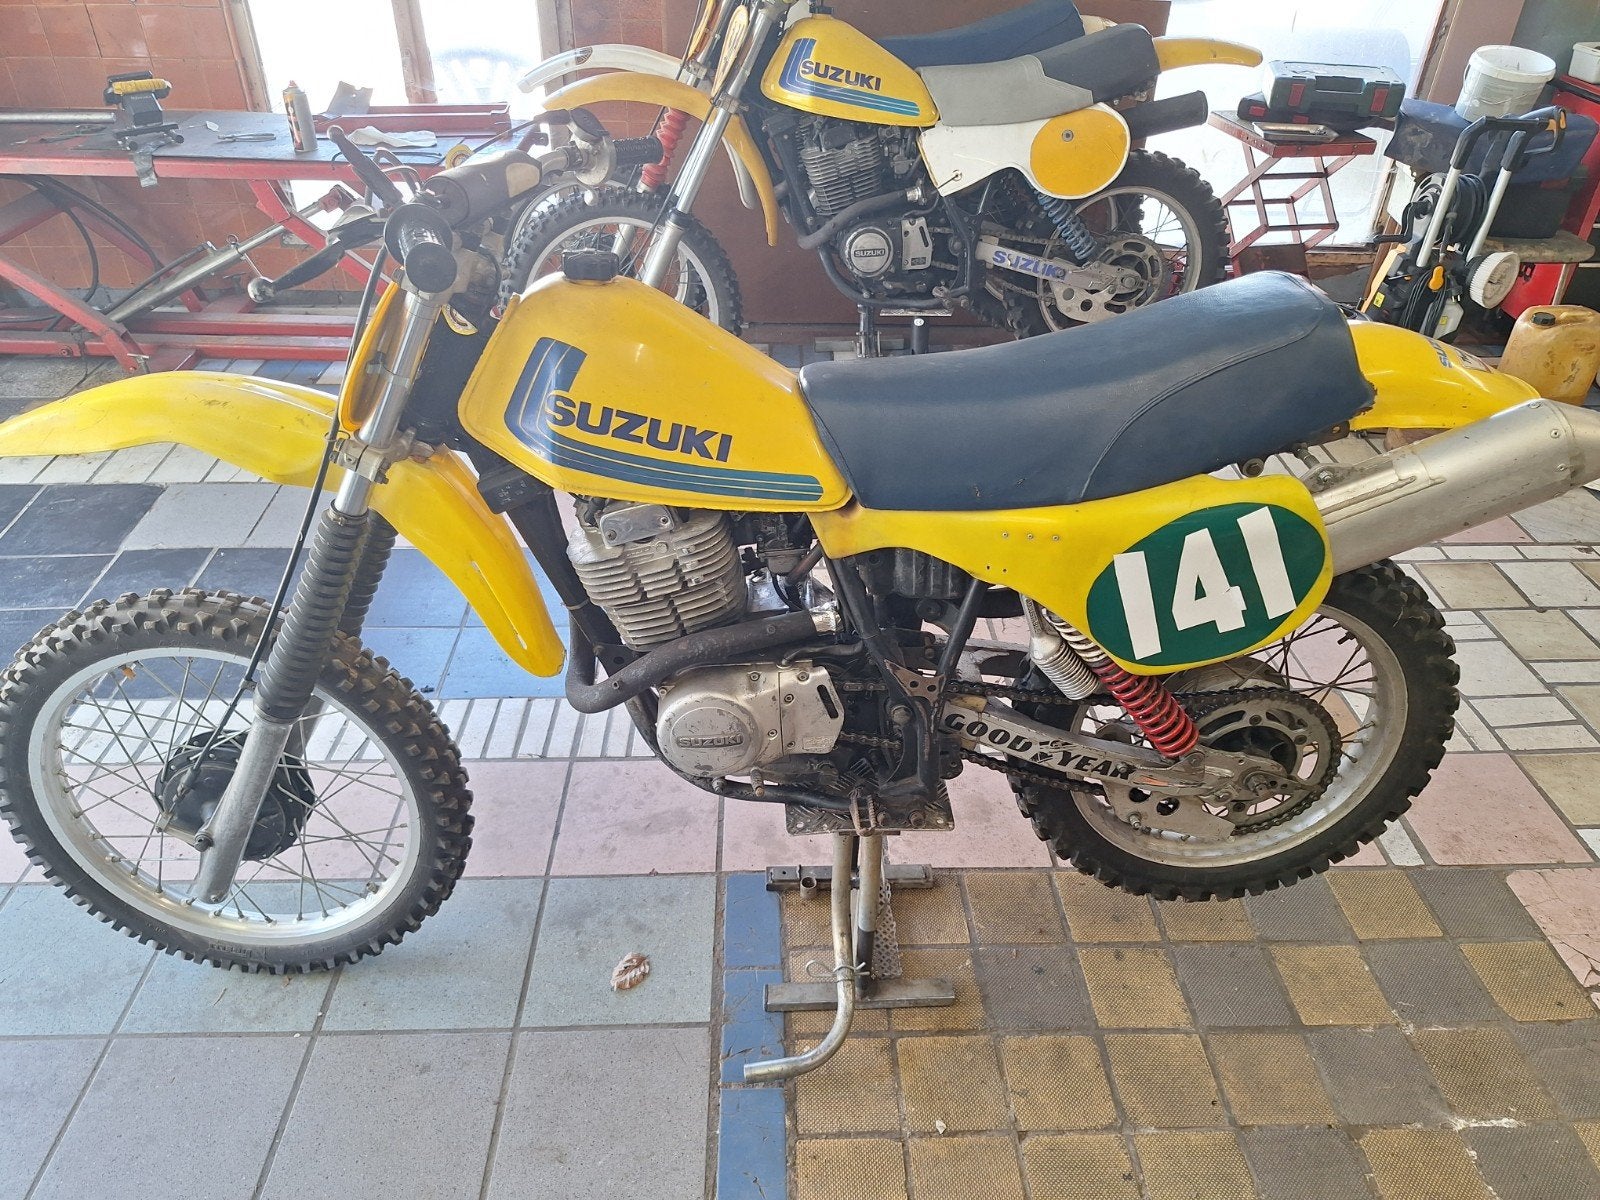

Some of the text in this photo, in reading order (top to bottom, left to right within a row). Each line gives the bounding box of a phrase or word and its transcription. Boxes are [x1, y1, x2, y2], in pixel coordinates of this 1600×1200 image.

[800, 59, 882, 92] SUZUKI
[854, 248, 886, 257] SUZUKI
[544, 394, 733, 463] SUZUKI
[1113, 505, 1298, 661] 141
[678, 733, 743, 748] SUZUKI
[944, 713, 1137, 781] GOOD YEAR
